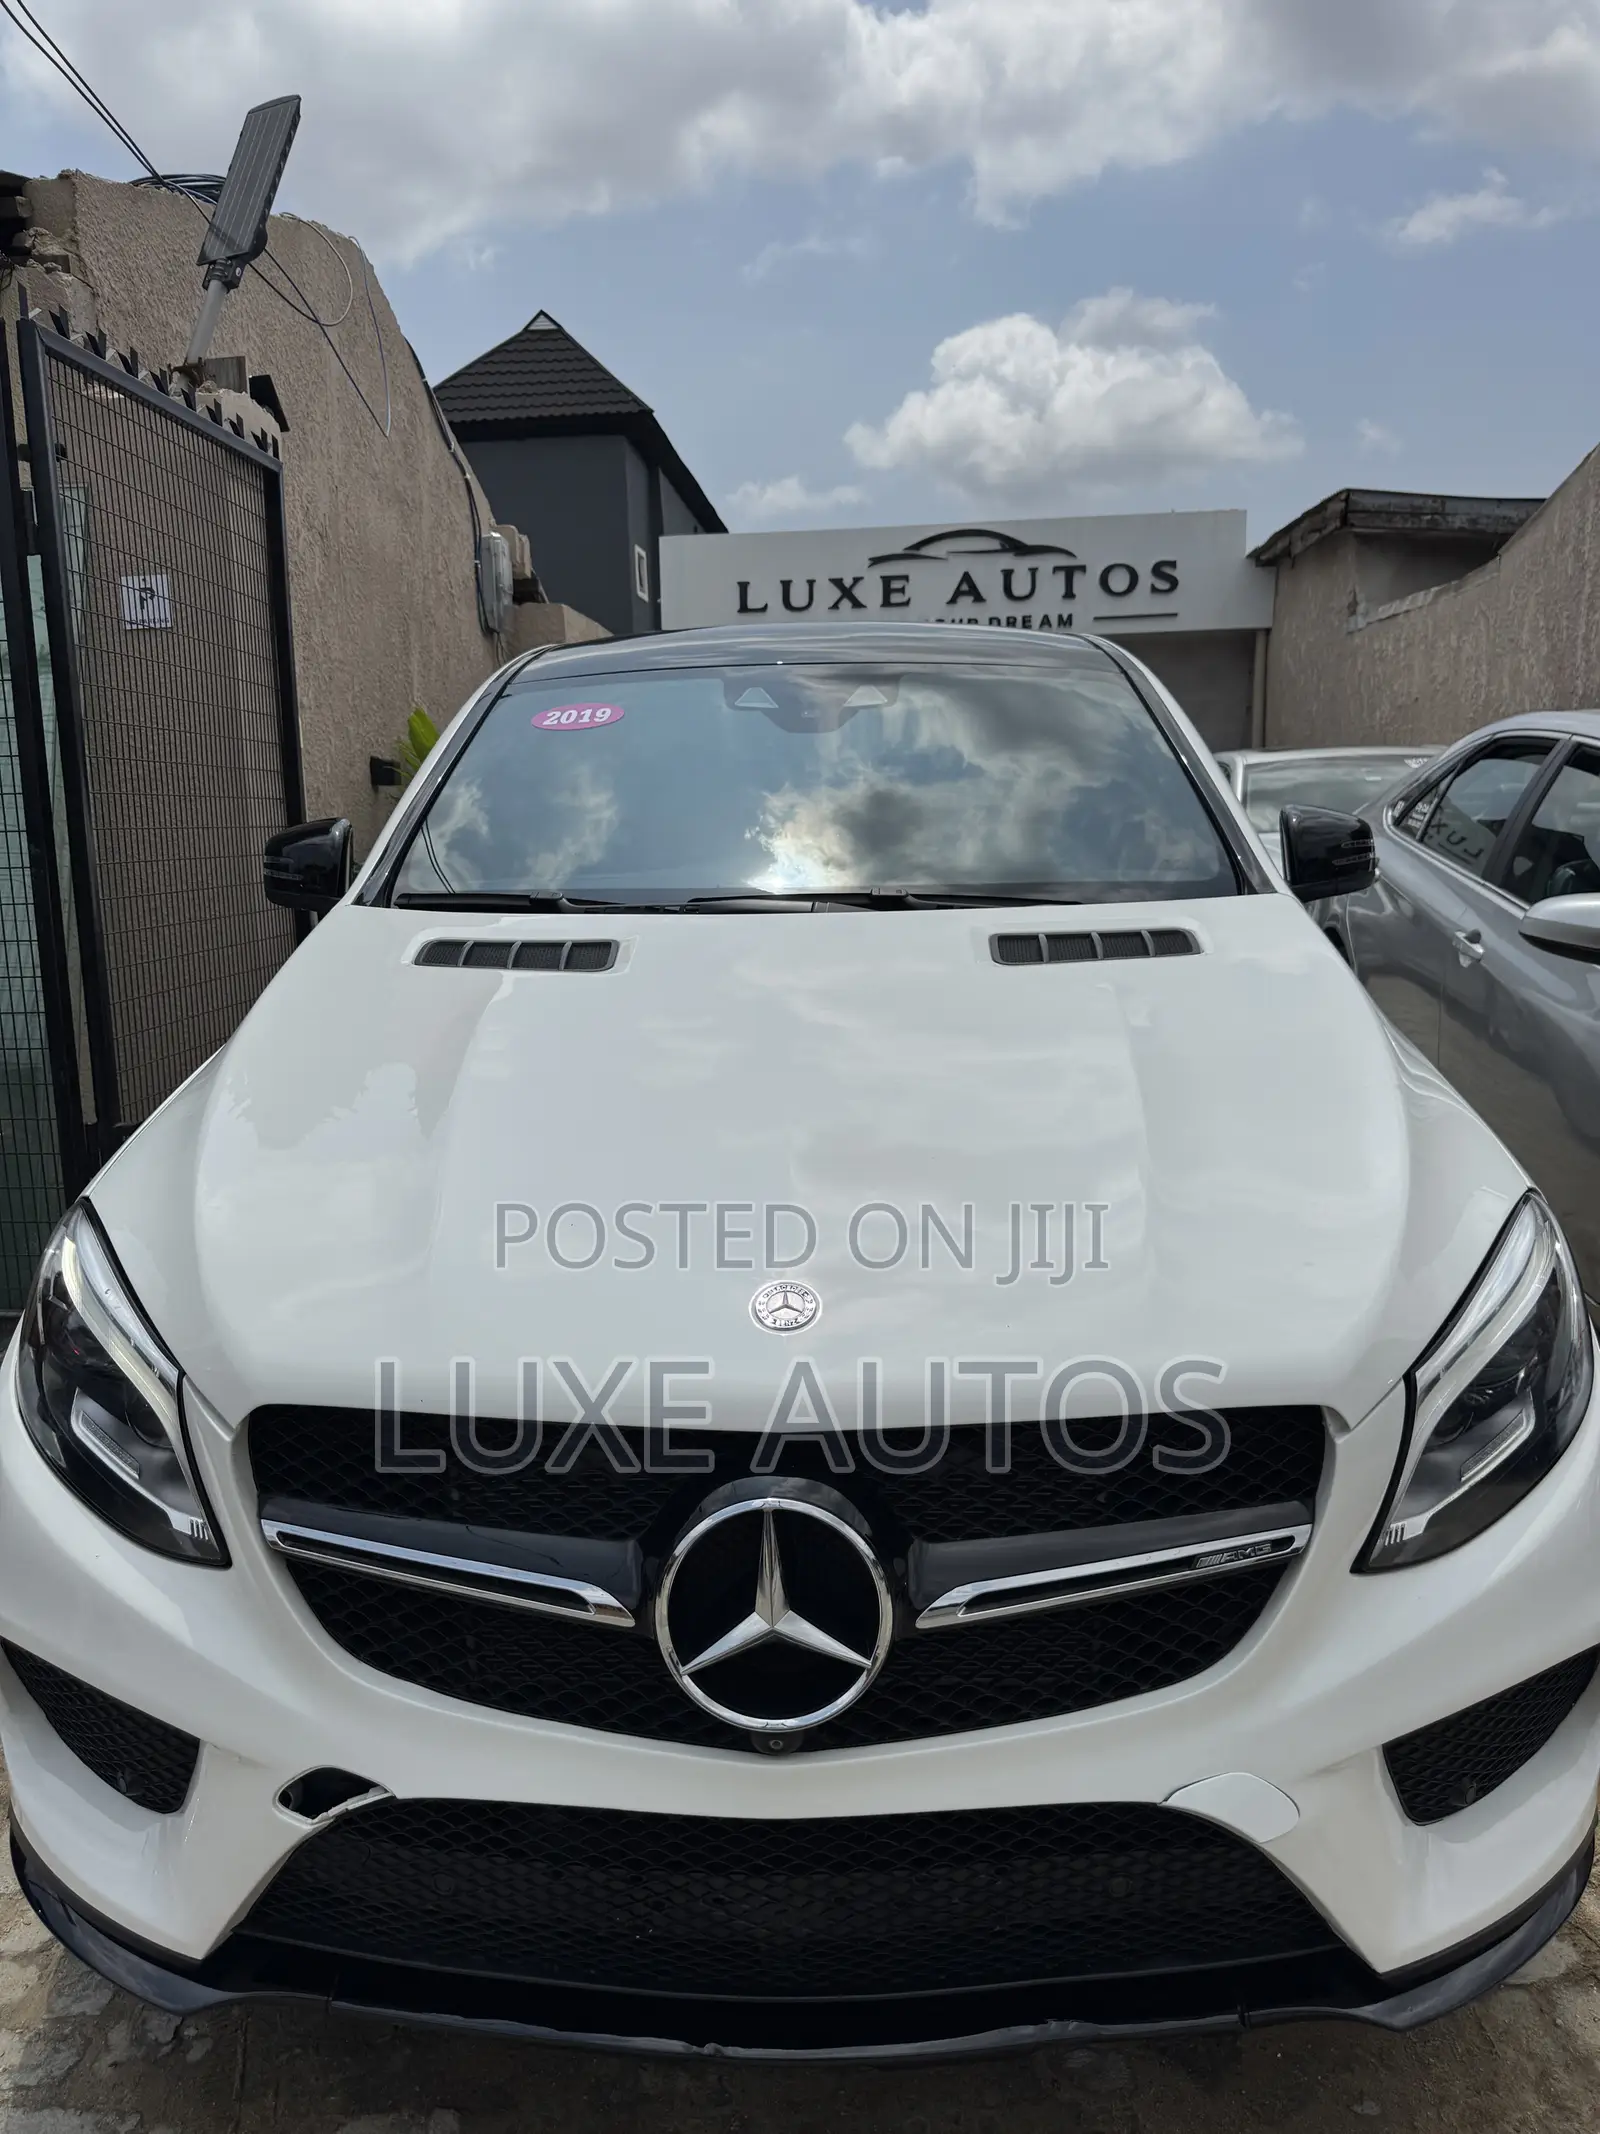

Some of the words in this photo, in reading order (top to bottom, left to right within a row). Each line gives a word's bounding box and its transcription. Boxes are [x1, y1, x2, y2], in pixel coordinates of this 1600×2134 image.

[736, 573, 911, 614] LUXE
[946, 559, 1180, 605] AUTOS
[988, 613, 1073, 629] DREAM
[542, 707, 612, 726] 2019
[1220, 1543, 1272, 1562] AMG
